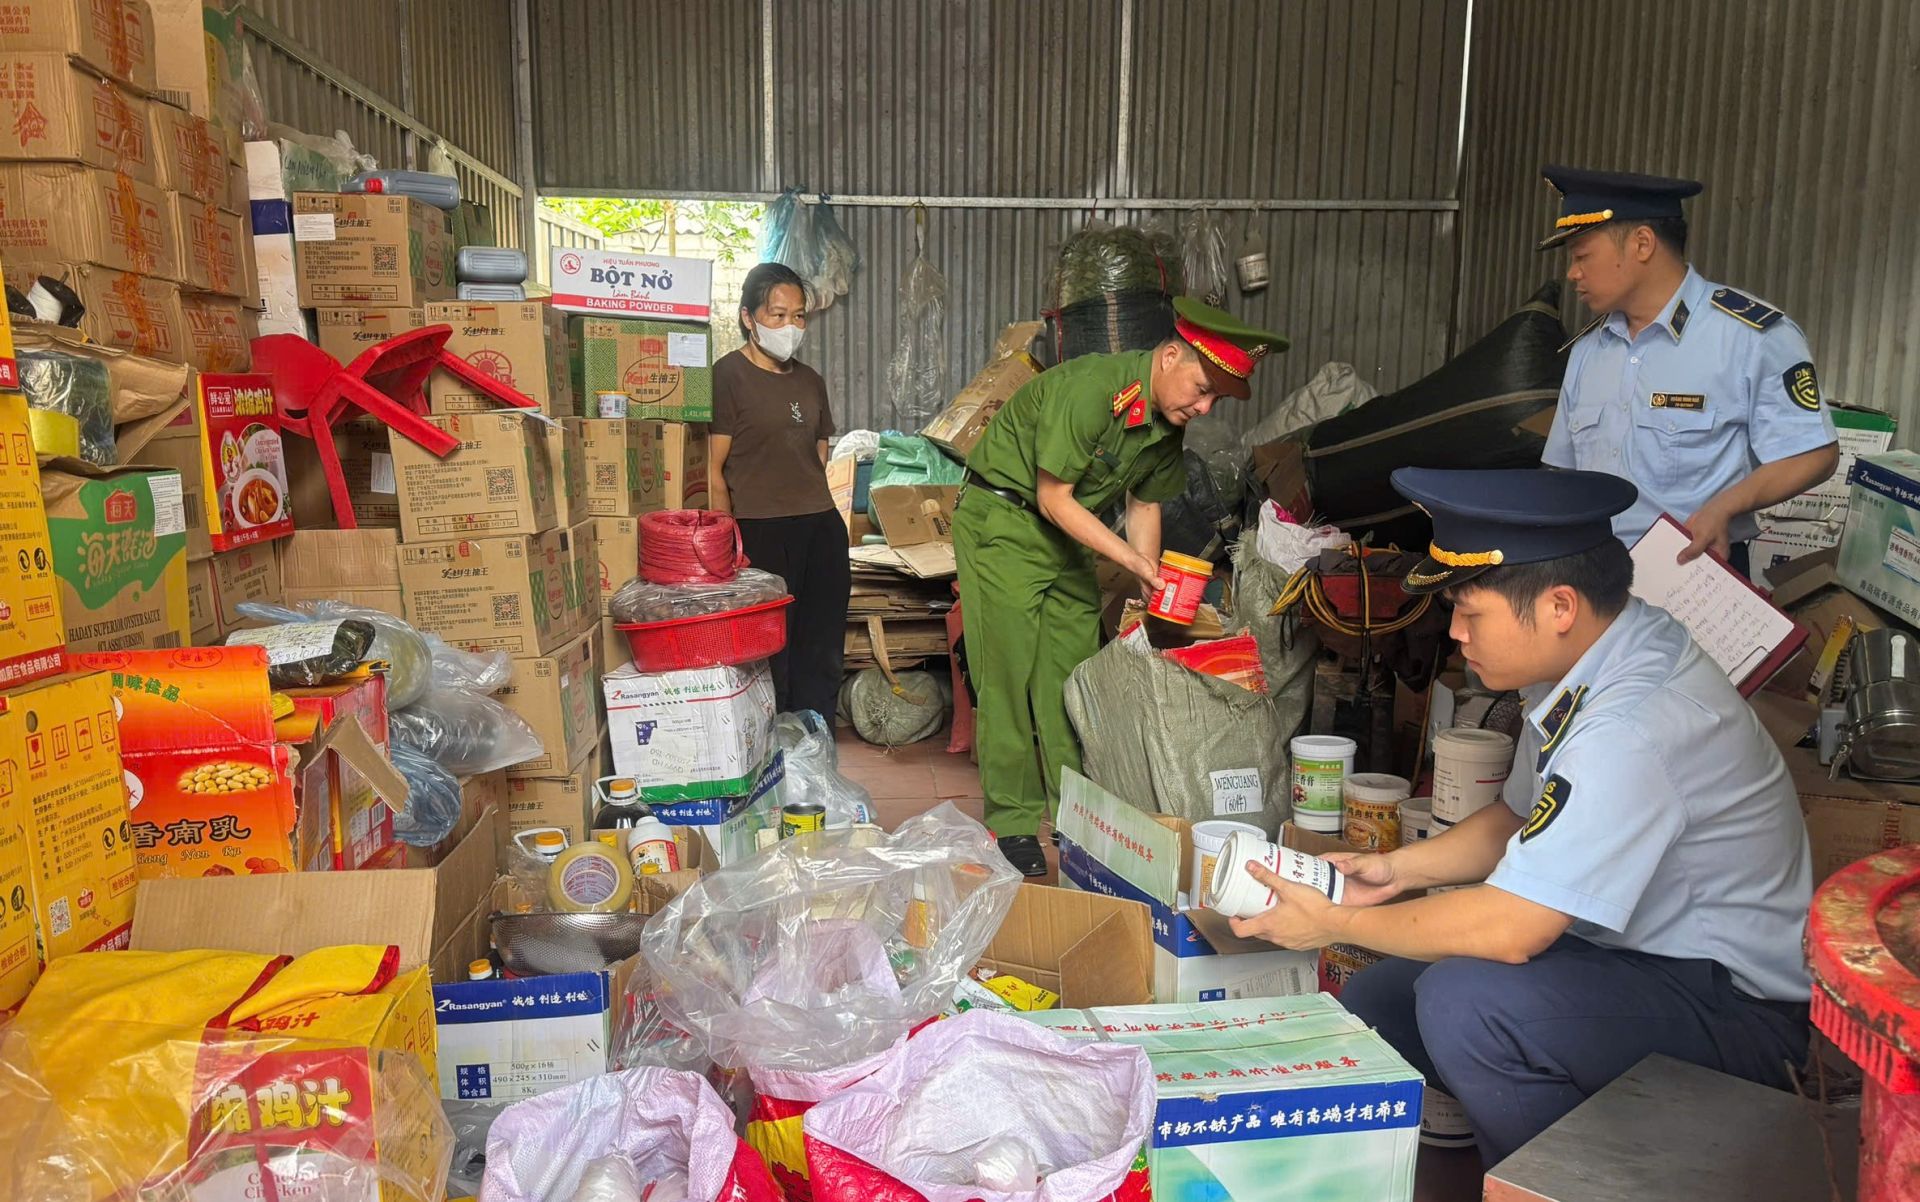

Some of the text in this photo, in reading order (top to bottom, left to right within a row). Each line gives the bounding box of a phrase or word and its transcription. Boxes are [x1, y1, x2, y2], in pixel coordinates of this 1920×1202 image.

[590, 265, 673, 290] BỘT NỞ
[586, 297, 674, 313] BAKING POWDER
[1859, 579, 1920, 623] 青岛瑞香源食品有
[68, 608, 162, 643] HADAY SUPERIOR OYSTER SAUCE
[620, 691, 660, 700] Rasangyan
[1214, 774, 1259, 790] WENGUANG
[94, 929, 130, 952] 食品有限
[449, 1000, 504, 1012] Rasangyan
[259, 1012, 320, 1031] 鸡汁
[460, 1066, 486, 1076] 规格
[460, 1077, 487, 1087] 体积
[461, 1087, 488, 1097] 净含量
[1158, 1100, 1407, 1141] 市场不缺产品 唯有高端才有希望
